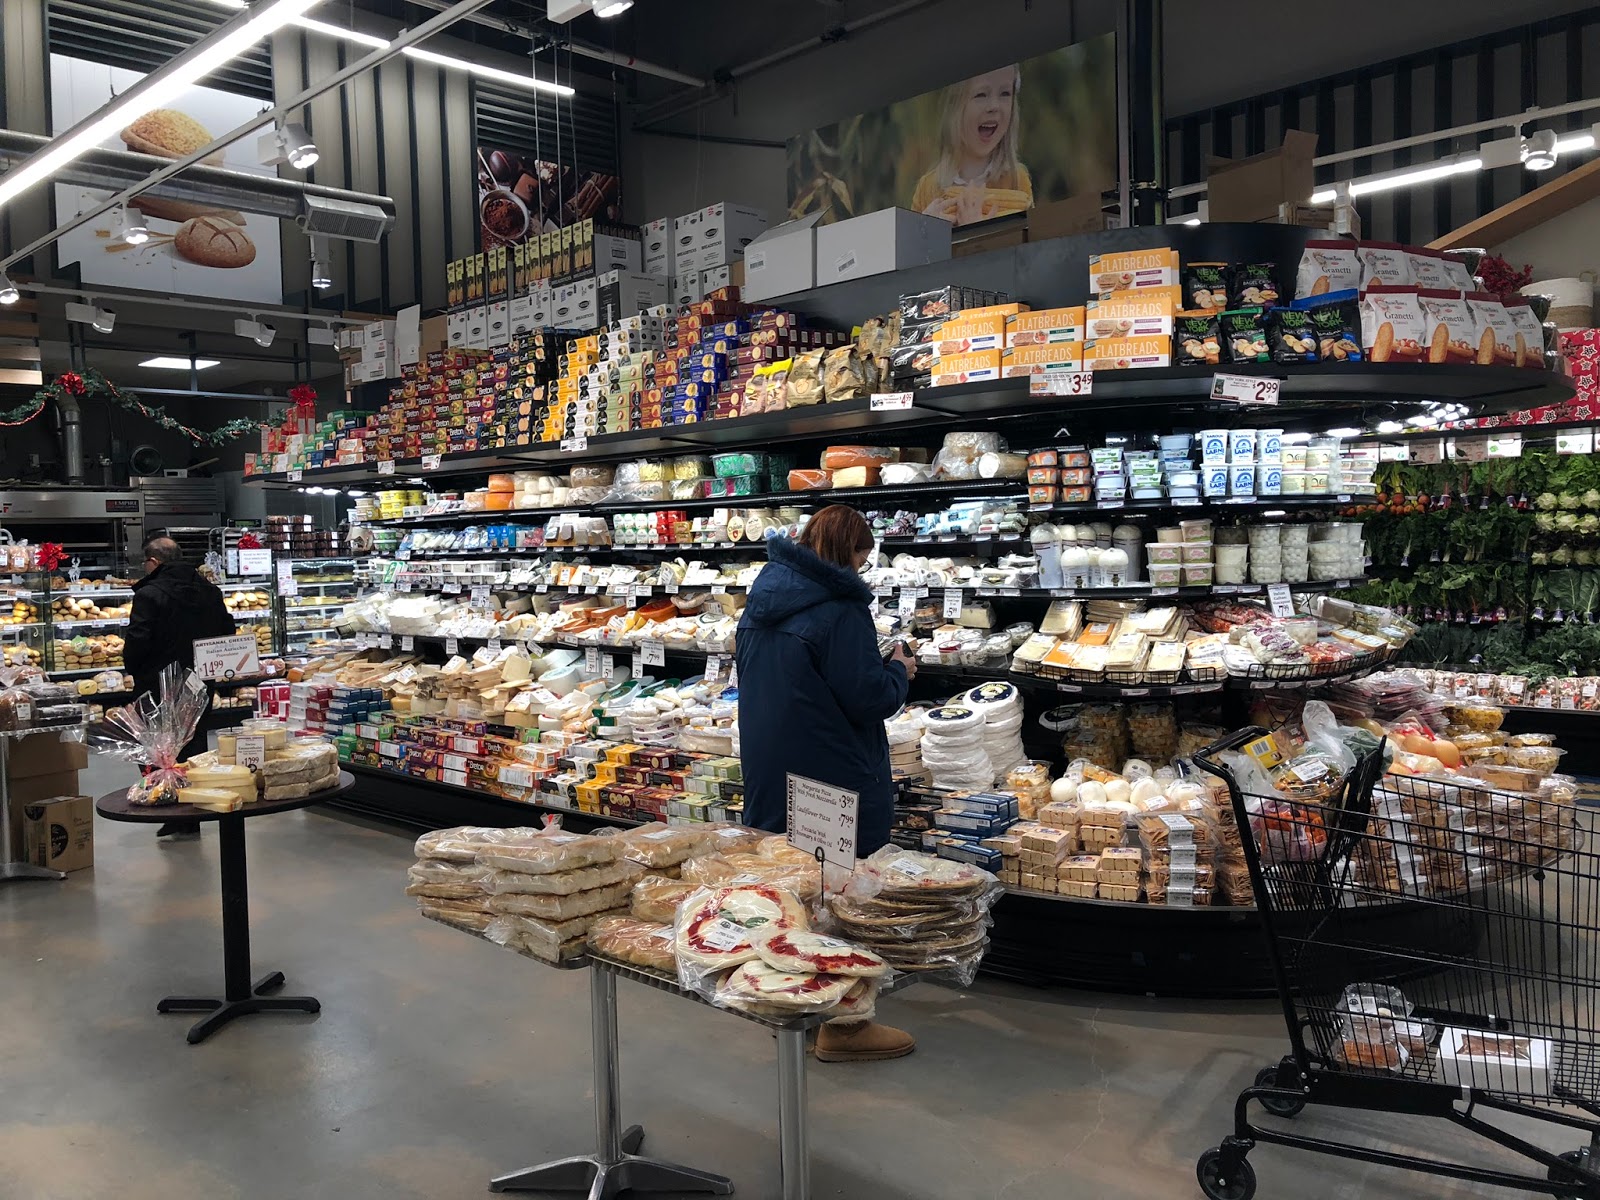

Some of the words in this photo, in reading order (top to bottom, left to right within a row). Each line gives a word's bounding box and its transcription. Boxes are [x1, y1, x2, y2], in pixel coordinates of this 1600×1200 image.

[1101, 255, 1161, 272] FLATBREADS
[1199, 274, 1220, 283] YORK
[1099, 303, 1162, 318] FLATBREADS
[1385, 311, 1414, 320] Granetti
[1017, 314, 1074, 331] FLATBREADS
[1232, 316, 1254, 324] NEW
[1284, 319, 1307, 327] YORK
[1315, 319, 1344, 328] YORK
[942, 322, 994, 339] FLATBREADS
[1014, 348, 1072, 364] FLATBREADS
[1096, 341, 1159, 358] FLATBREADS
[941, 355, 990, 373] FLATBREADS
[821, 789, 832, 797] Pizza
[816, 794, 837, 806] Mozzarella
[797, 806, 818, 817] Cauliflower
[819, 813, 830, 822] Pizza
[796, 830, 813, 841] Rosemary
